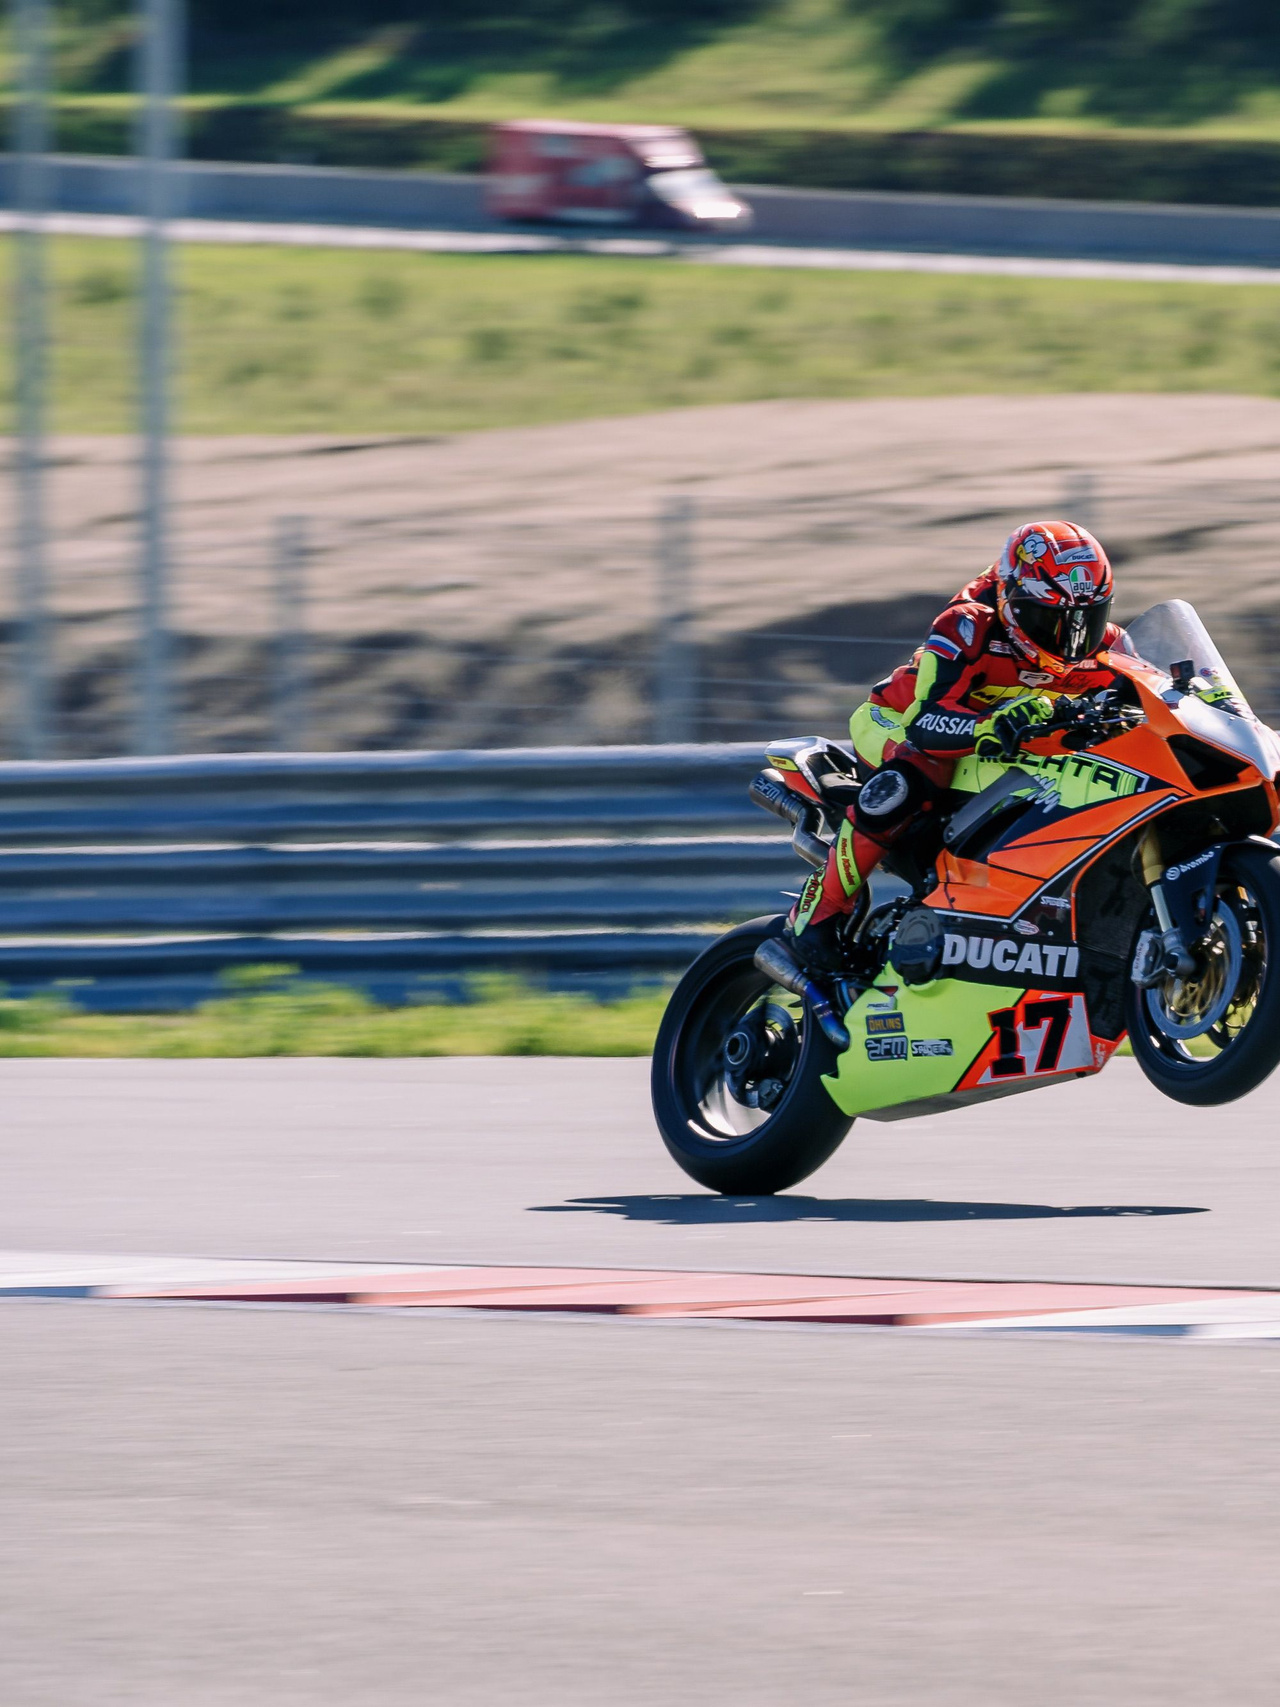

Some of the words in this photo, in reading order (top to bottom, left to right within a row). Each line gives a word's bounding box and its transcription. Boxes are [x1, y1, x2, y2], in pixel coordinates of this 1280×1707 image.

[915, 713, 976, 735] RUSSIA
[942, 933, 1080, 977] DUCATI
[987, 996, 1073, 1078] 17
